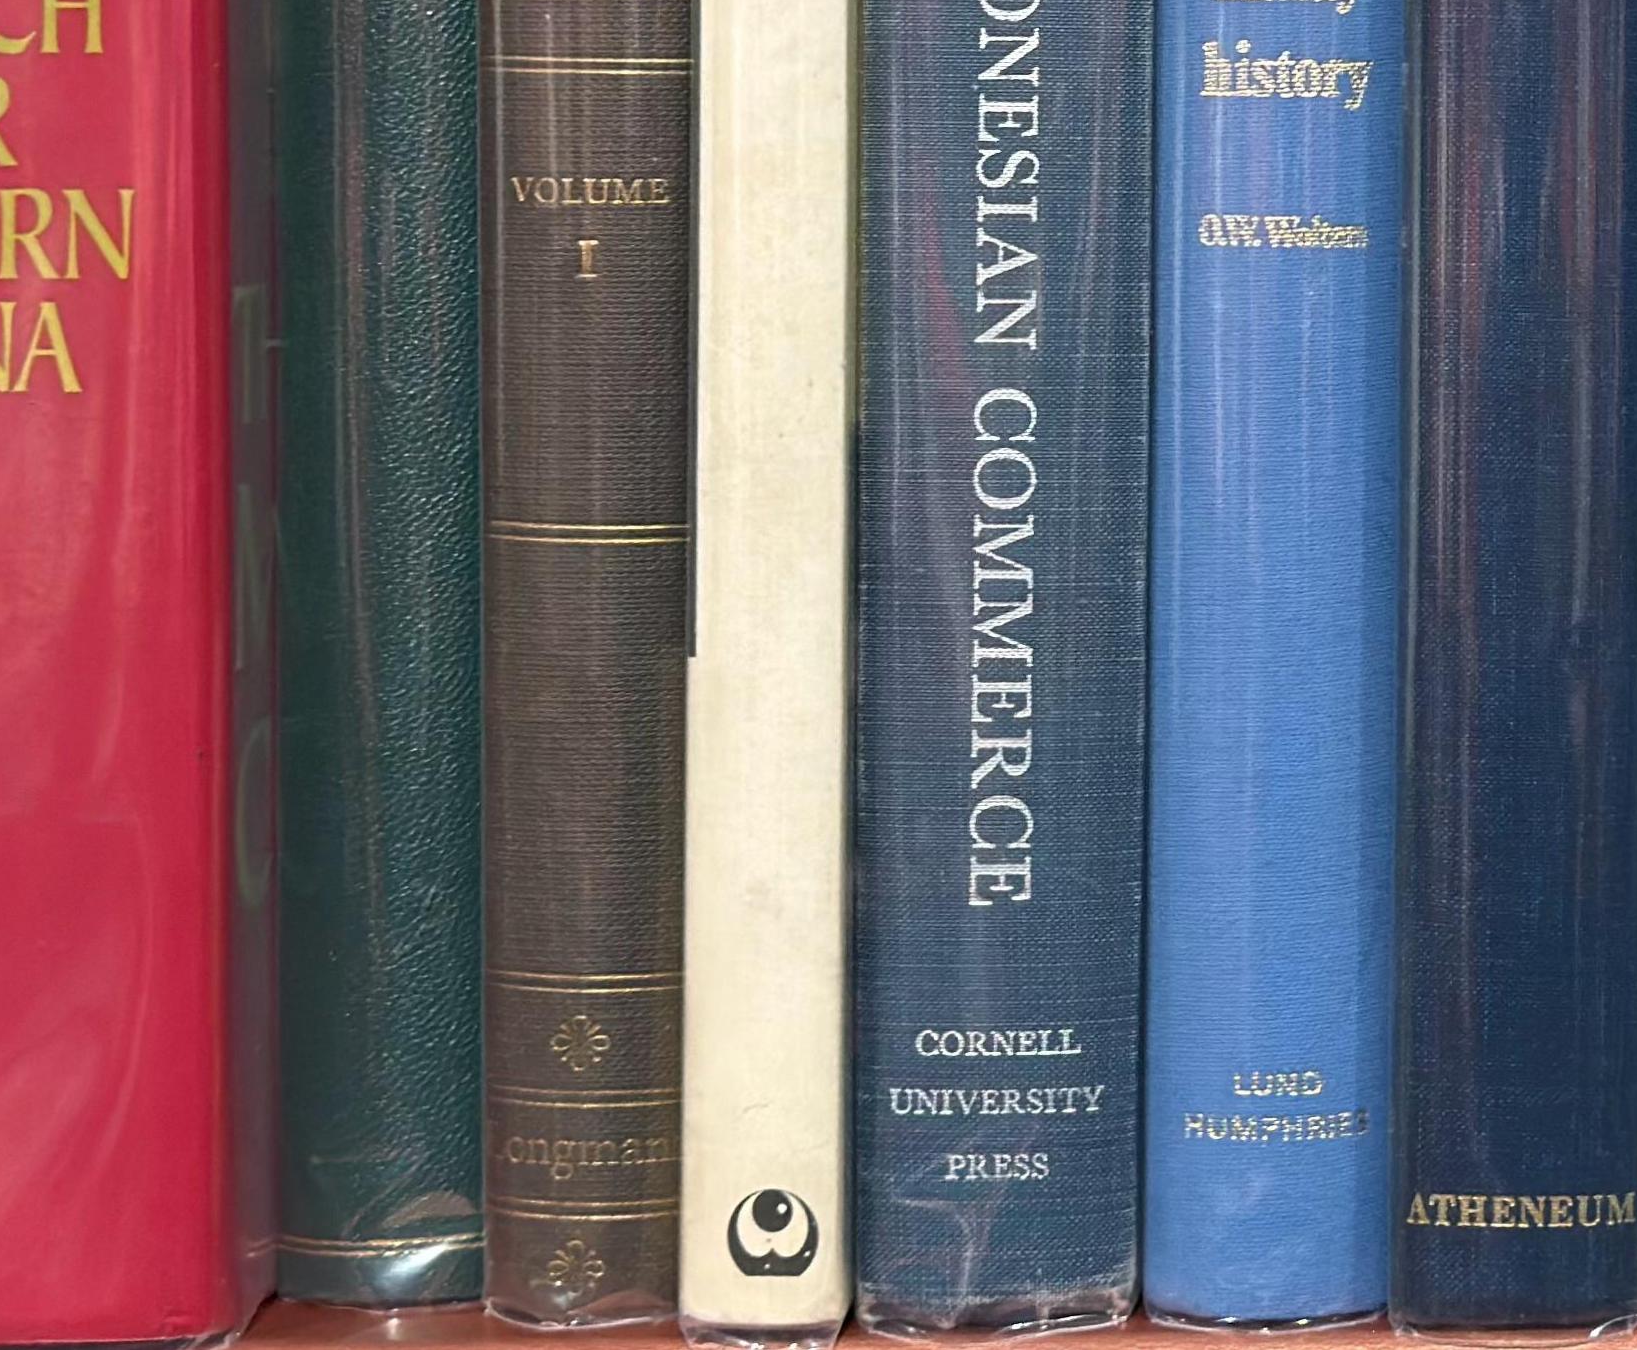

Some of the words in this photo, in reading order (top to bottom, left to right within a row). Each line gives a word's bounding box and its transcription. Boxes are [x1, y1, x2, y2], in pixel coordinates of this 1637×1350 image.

[1200, 40, 1373, 111] history
[510, 176, 670, 206] VOLUME
[578, 239, 600, 278] I
[967, 387, 1039, 908] COMMERCE
[915, 1028, 1082, 1057] CORNELL
[1233, 1069, 1323, 1098] LUND
[889, 1084, 1105, 1116] UNIVERSITY
[945, 1152, 1050, 1182] PRESS
[1406, 1191, 1637, 1228] ATHENEUM
